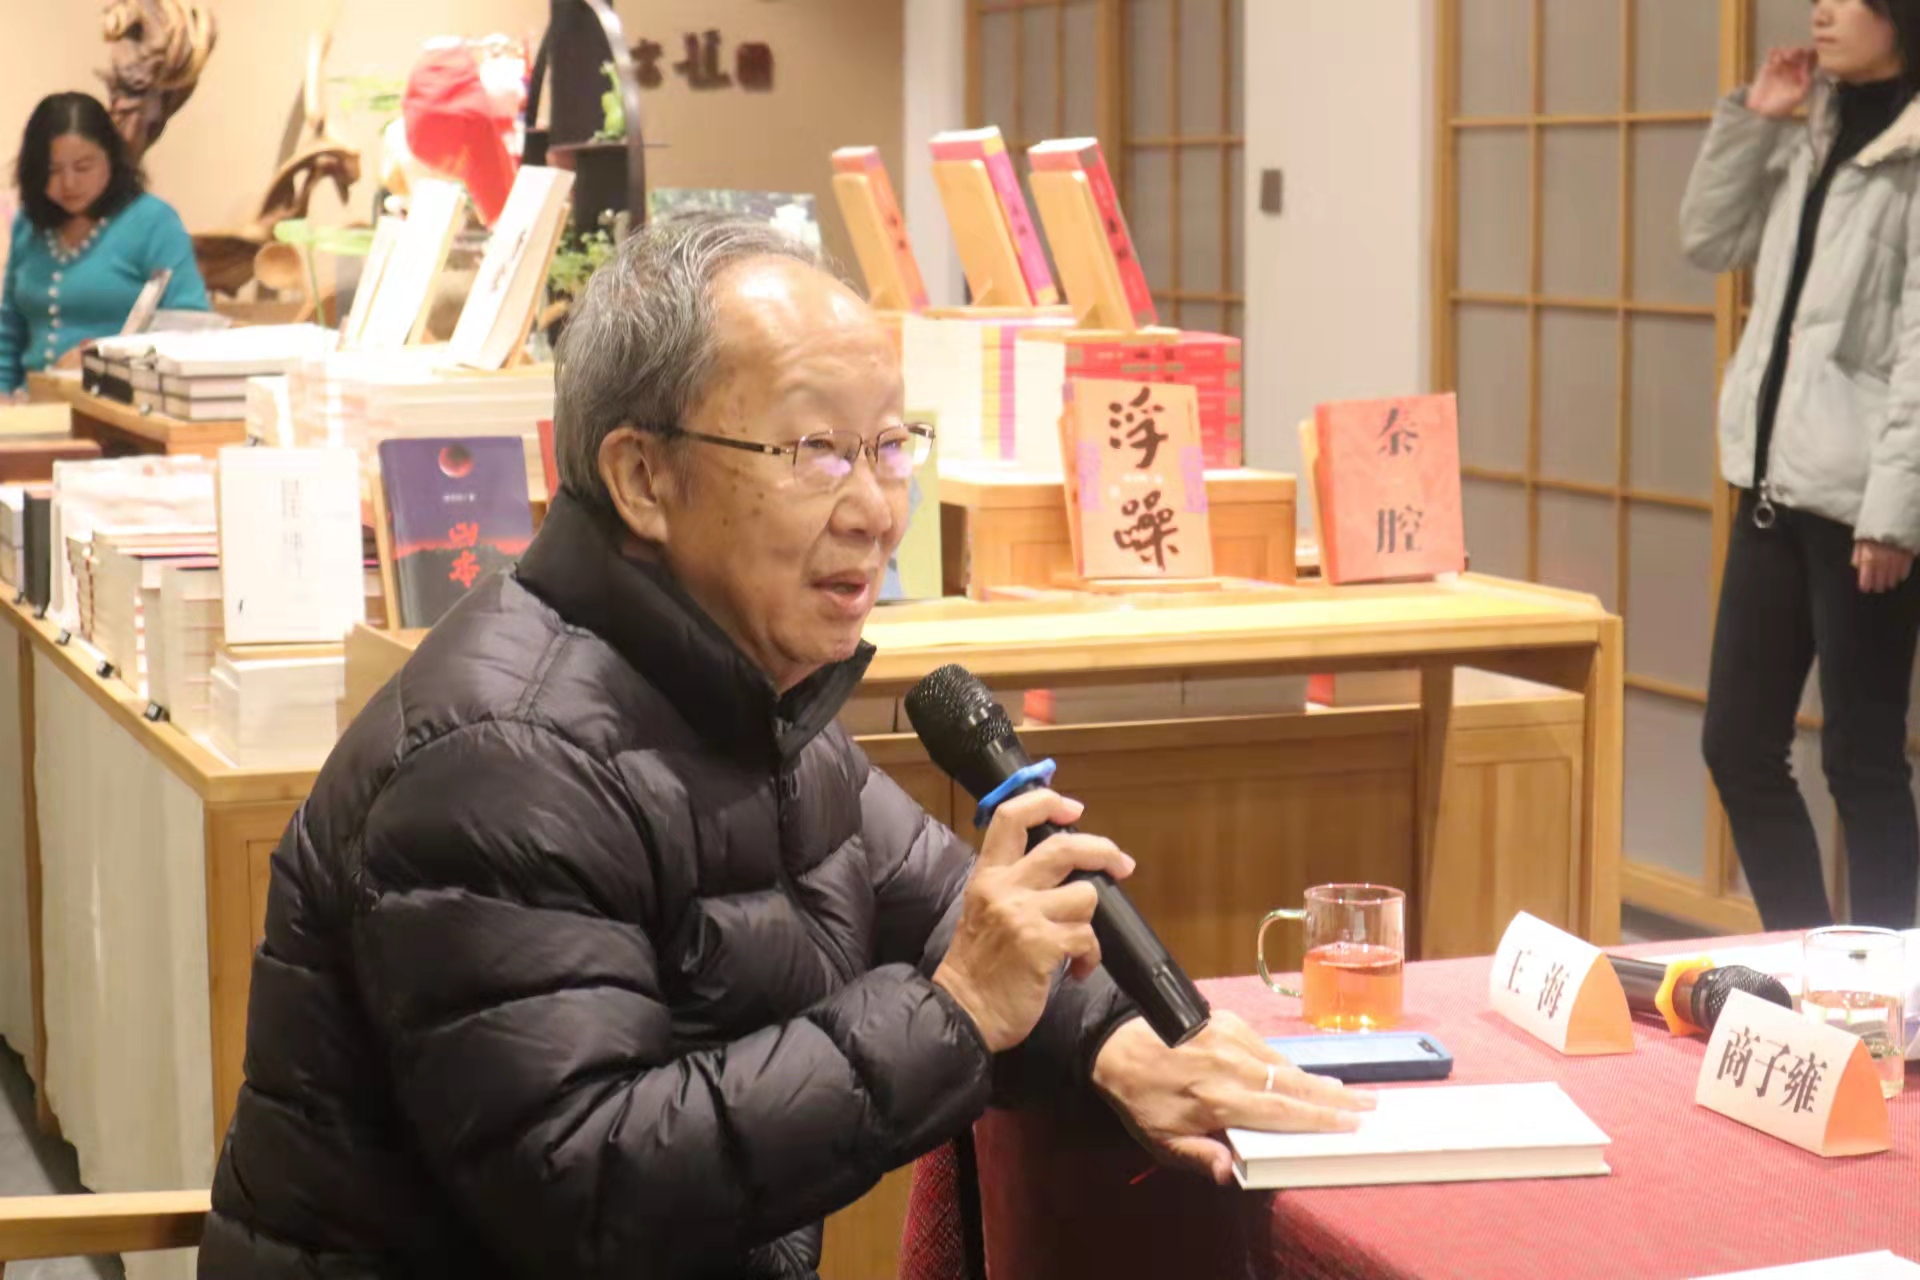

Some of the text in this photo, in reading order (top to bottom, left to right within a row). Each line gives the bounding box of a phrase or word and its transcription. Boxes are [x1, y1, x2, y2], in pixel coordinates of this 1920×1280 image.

[1376, 408, 1422, 553] 秦腔
[1717, 1026, 1827, 1113] 商子雍
